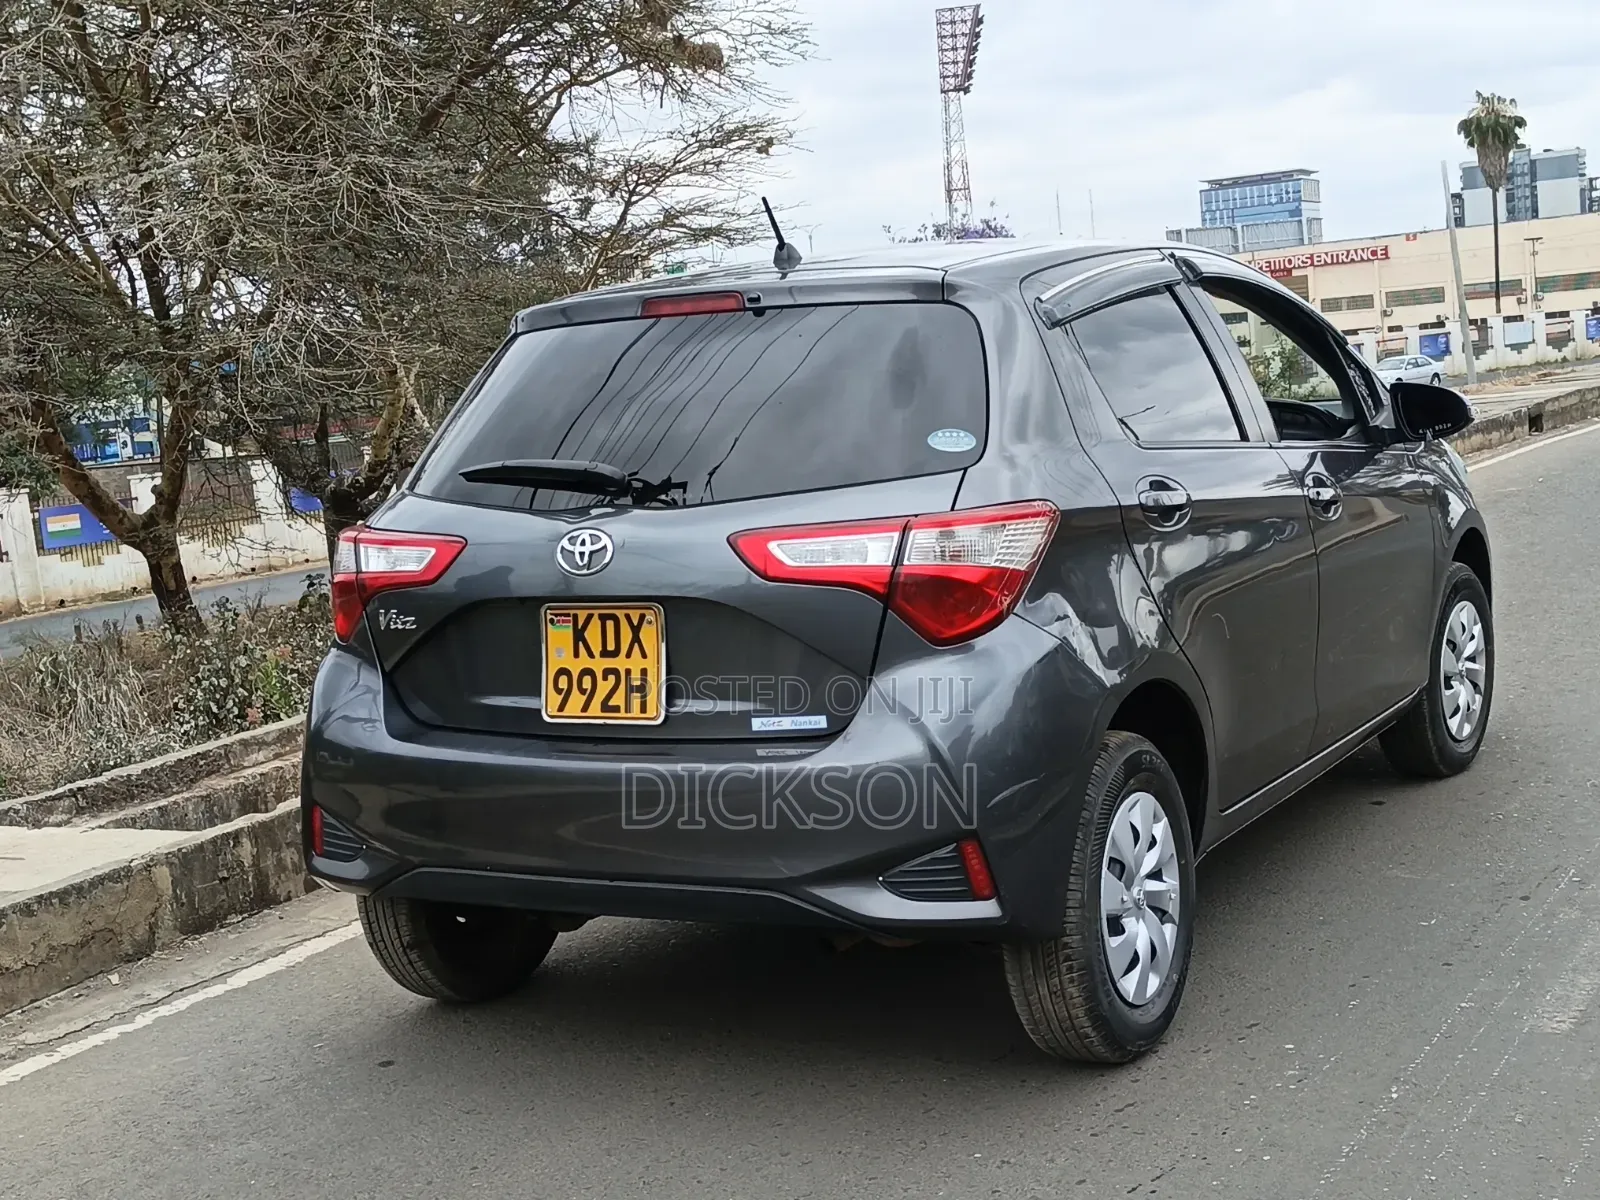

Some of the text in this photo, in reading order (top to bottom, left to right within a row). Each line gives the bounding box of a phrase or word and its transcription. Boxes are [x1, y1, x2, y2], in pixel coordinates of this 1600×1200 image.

[1313, 246, 1386, 266] ENTRANCE
[379, 609, 417, 630] Vitz
[571, 613, 648, 659] KDX
[552, 667, 648, 714] 992H
[790, 718, 822, 727] Nankai
